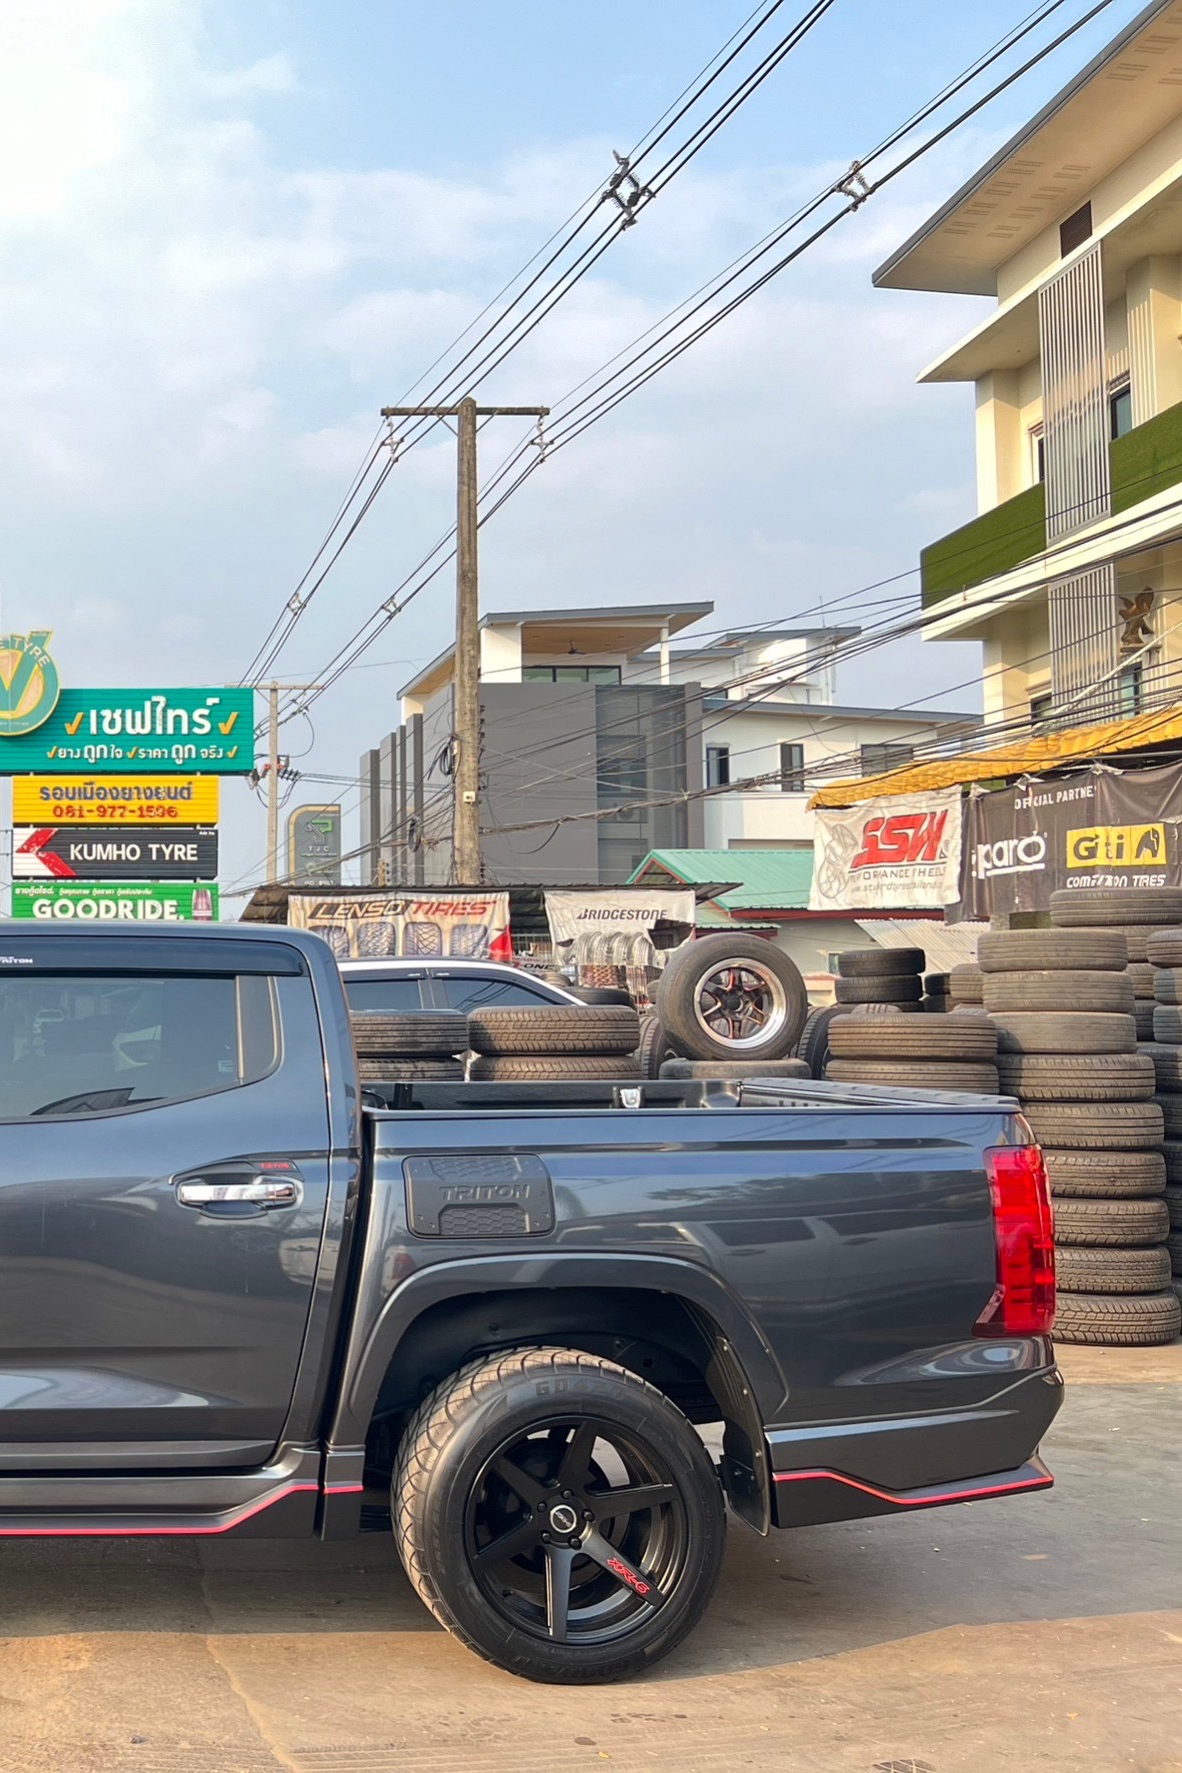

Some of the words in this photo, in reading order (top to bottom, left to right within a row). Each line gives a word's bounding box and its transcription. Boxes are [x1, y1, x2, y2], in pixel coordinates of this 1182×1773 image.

[12, 637, 51, 667] TYRE
[83, 744, 109, 764] ถูก
[171, 744, 197, 765] ถูก
[1056, 785, 1097, 804] PARTNE
[70, 843, 141, 861] KUMHO
[148, 844, 198, 861] TYRE
[1132, 873, 1167, 888] TIRES
[316, 899, 407, 919] LENSO
[411, 901, 497, 918] TIRES
[576, 907, 668, 921] BRIDGESTONE
[438, 1184, 530, 1201] TRITON
